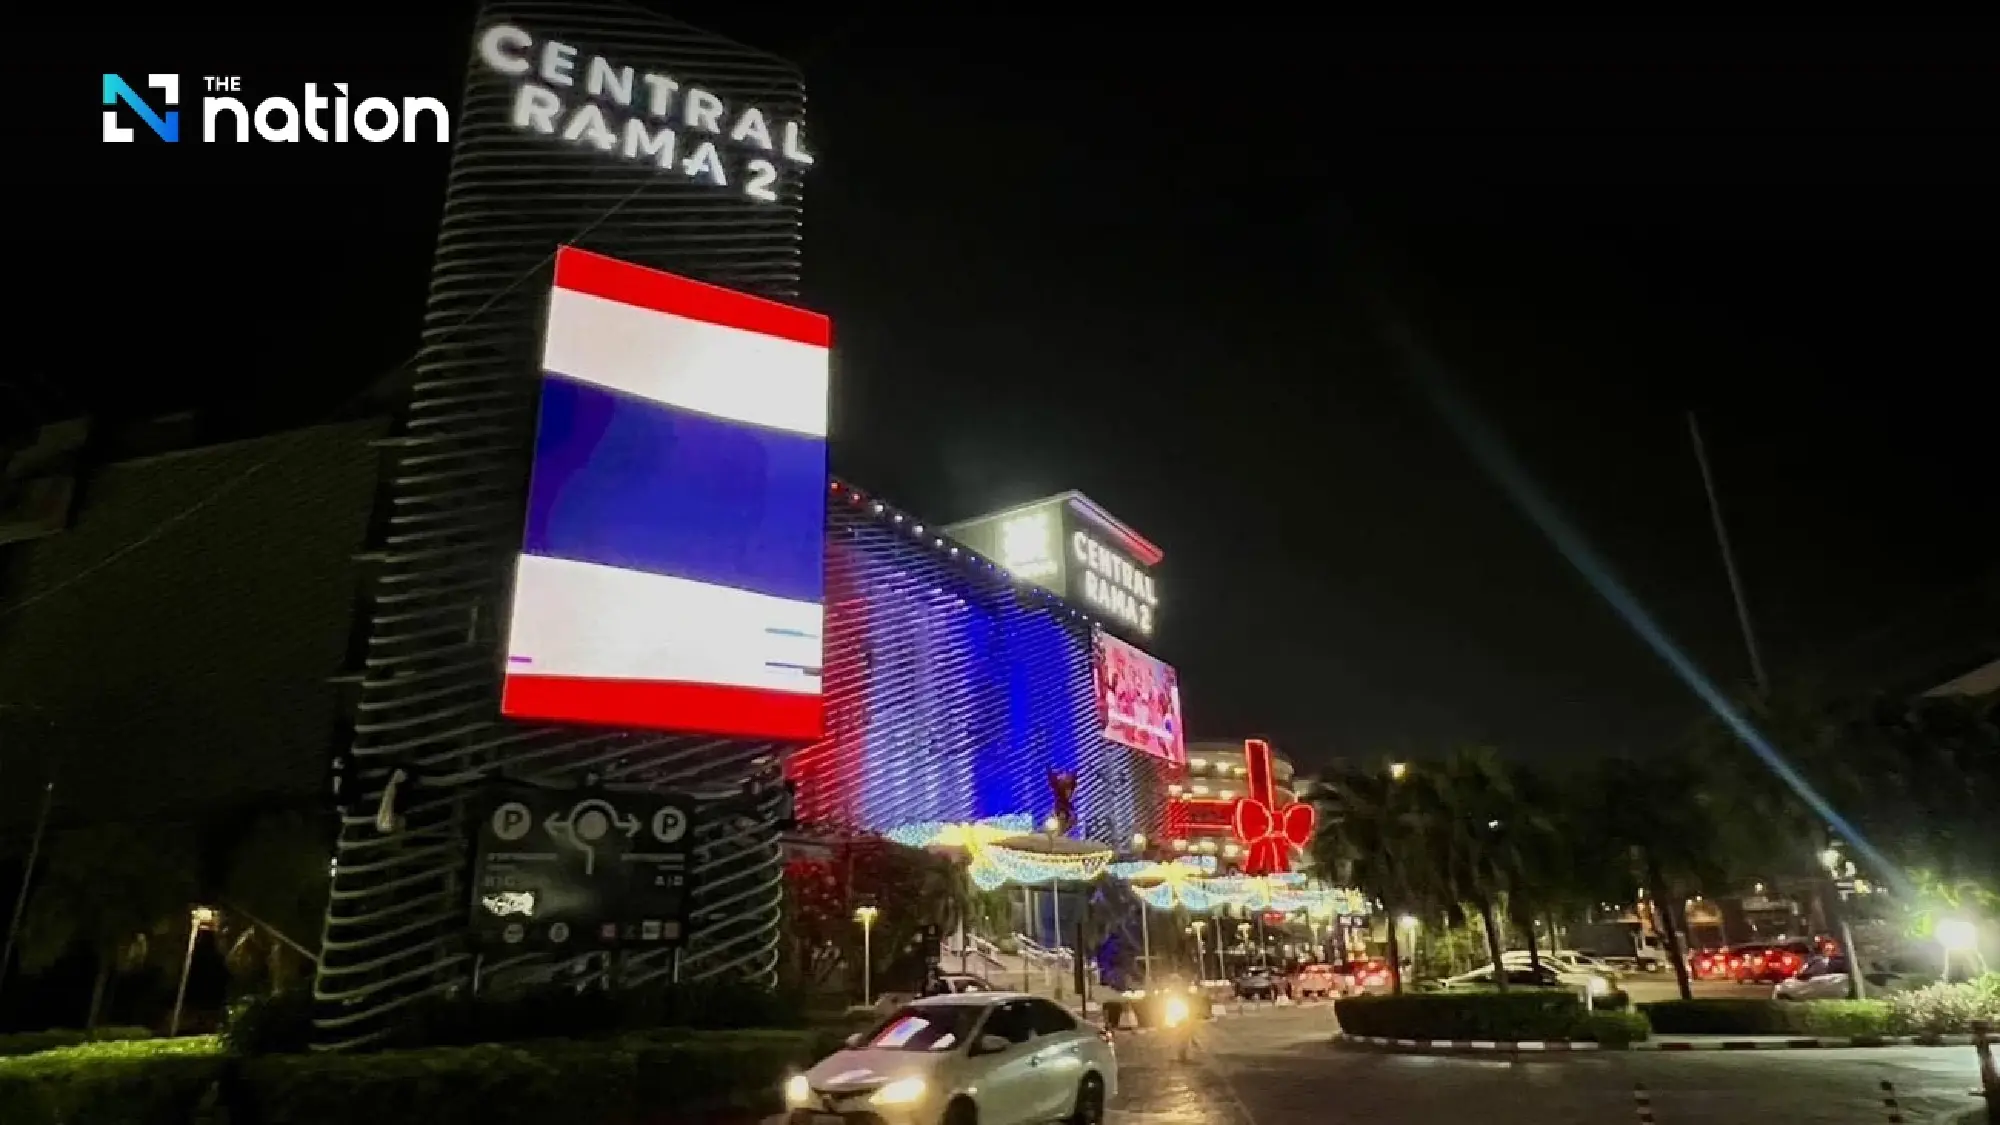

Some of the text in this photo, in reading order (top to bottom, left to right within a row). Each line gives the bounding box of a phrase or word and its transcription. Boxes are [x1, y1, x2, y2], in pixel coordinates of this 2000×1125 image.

[479, 25, 814, 164] CENTRAL
[513, 84, 777, 201] RAMA 2
[1073, 530, 1158, 606] CENTRAL
